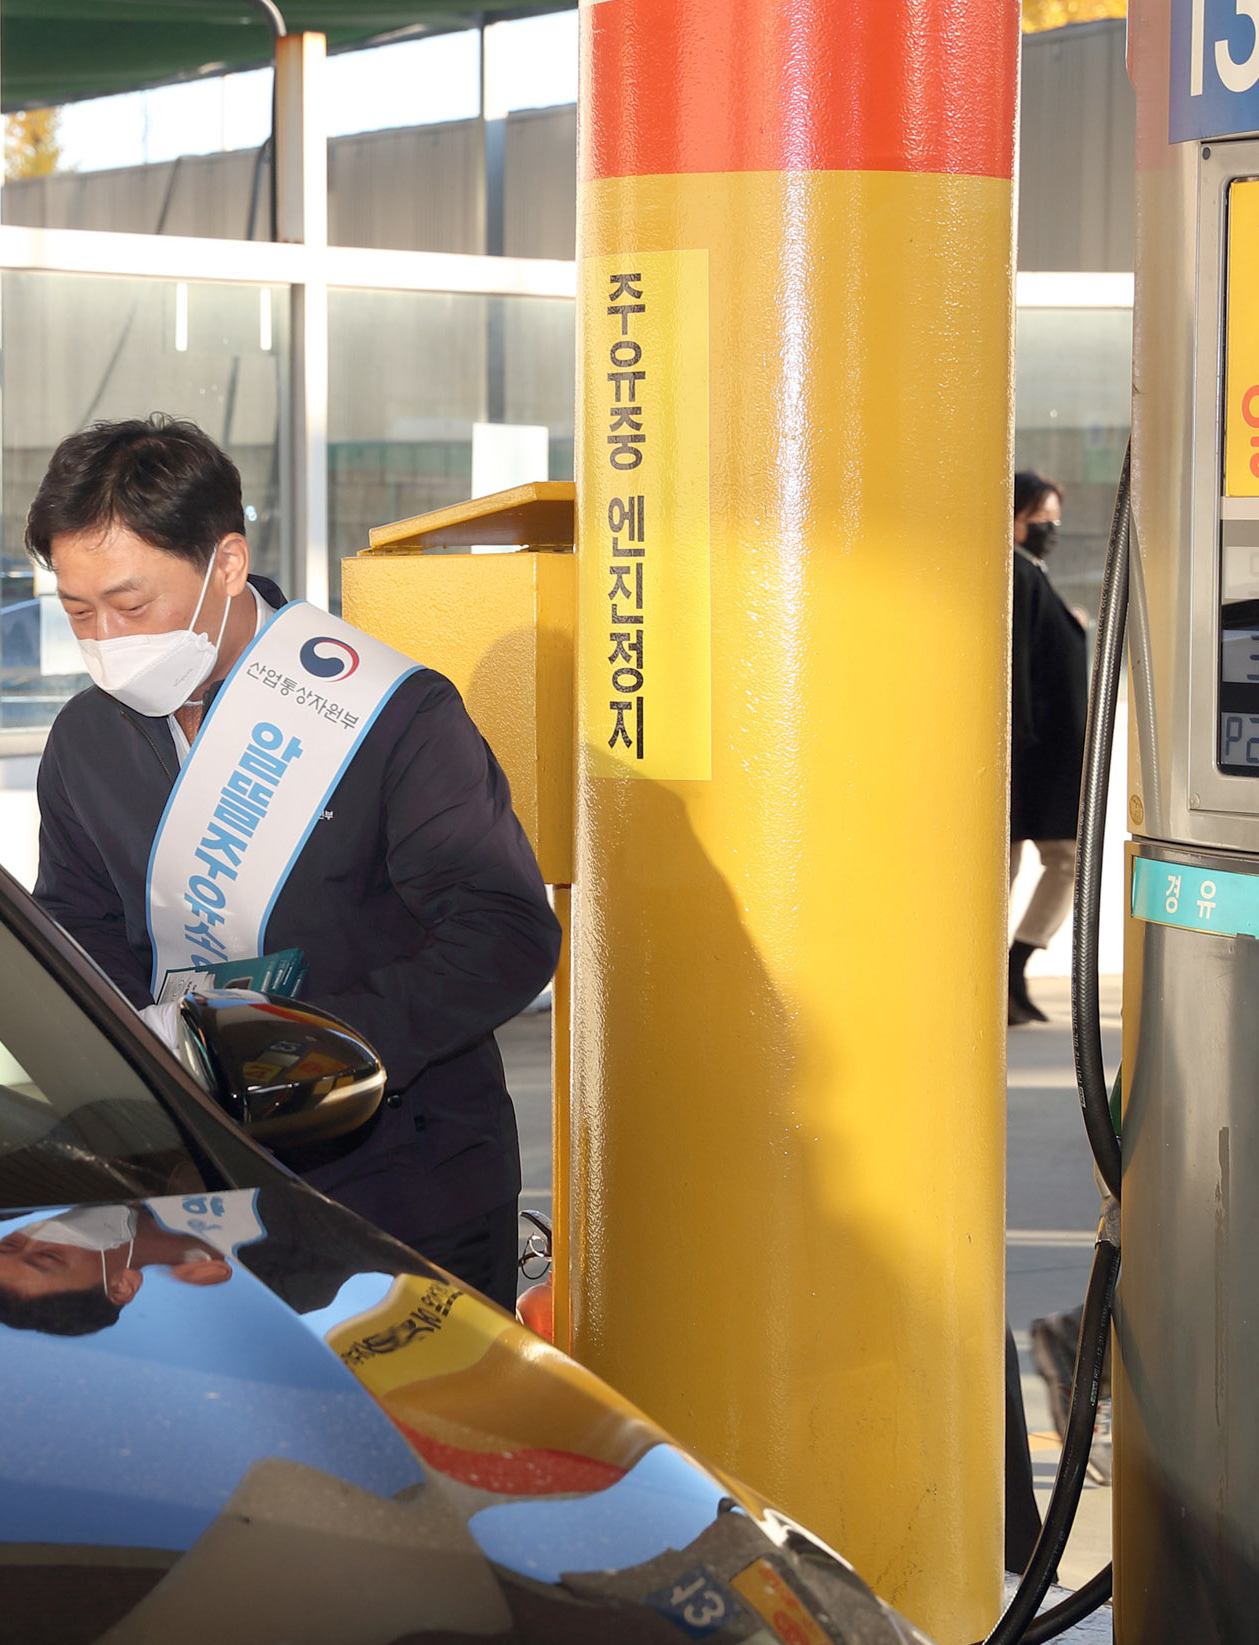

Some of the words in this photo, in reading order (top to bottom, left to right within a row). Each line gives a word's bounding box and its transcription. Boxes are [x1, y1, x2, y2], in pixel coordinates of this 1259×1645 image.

[606, 273, 646, 471] 주유중
[246, 662, 360, 730] 산업통상자원부
[607, 494, 645, 761] 엔진정지
